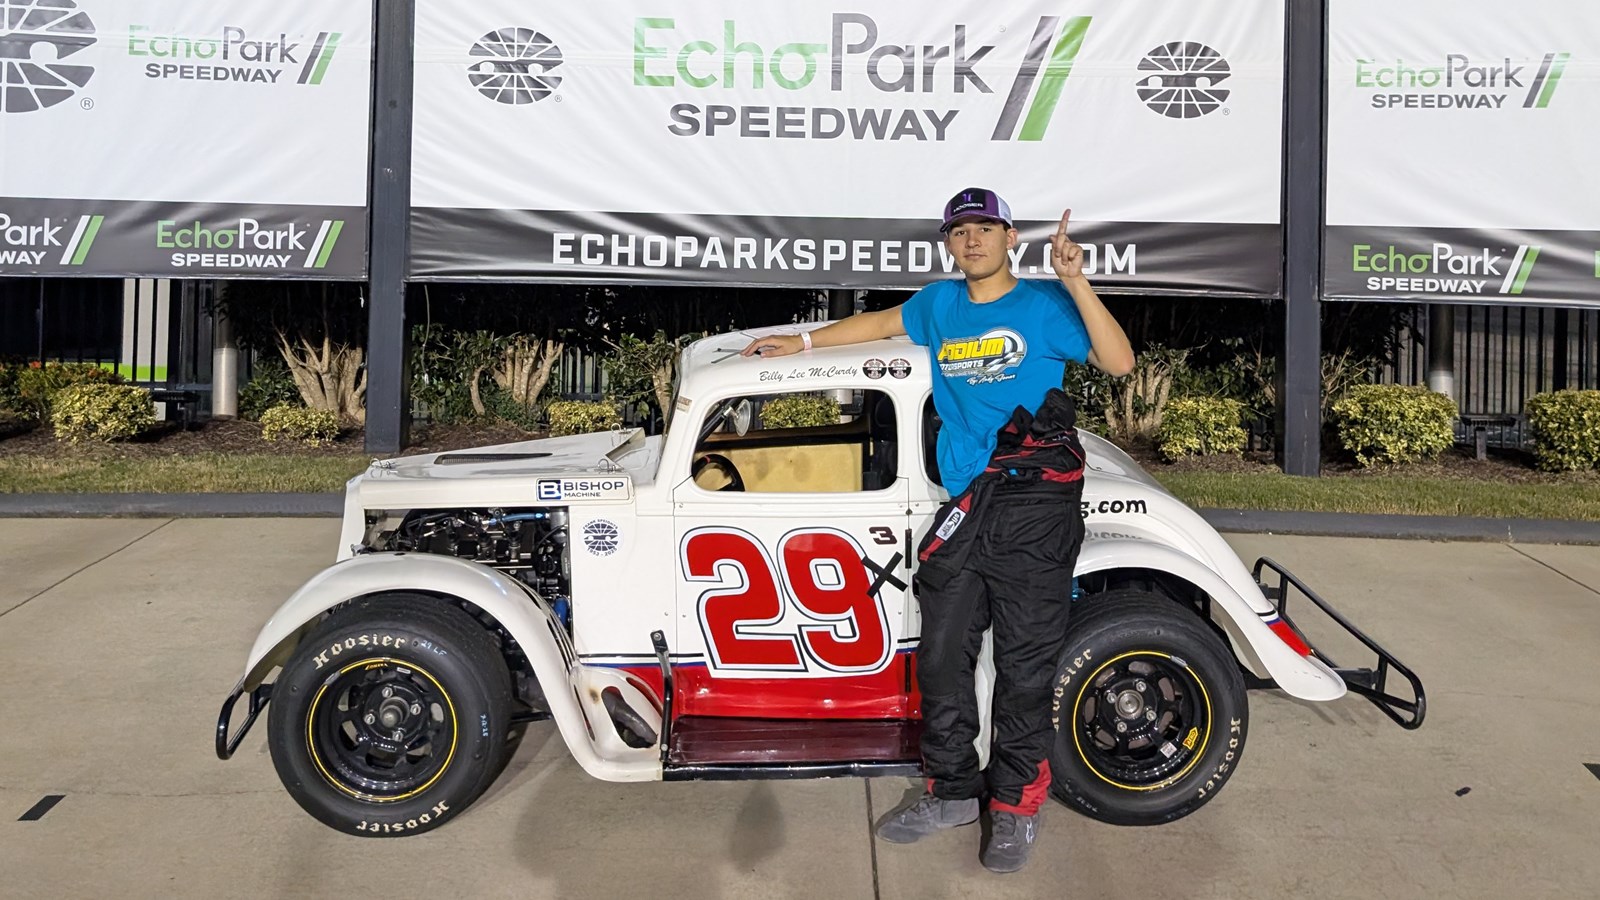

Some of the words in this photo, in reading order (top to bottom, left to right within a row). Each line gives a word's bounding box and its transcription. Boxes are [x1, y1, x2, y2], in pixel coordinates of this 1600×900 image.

[128, 24, 299, 64] EchoPark
[634, 12, 996, 94] EchoPark
[144, 63, 283, 84] SPEEDWAY
[1355, 53, 1525, 88] EchoPark
[1371, 93, 1508, 109] SPEEDWAY
[667, 103, 960, 141] SPEEDWAY
[953, 202, 984, 213] HOOSIER
[156, 218, 306, 251] EchoPark
[171, 252, 292, 269] SPEEDWAY
[1353, 242, 1502, 276] EchoPark
[1366, 277, 1488, 294] SPEEDWAY
[759, 370, 784, 382] Billy
[787, 368, 806, 379] Lee
[808, 364, 858, 379] McCurdy
[563, 481, 624, 491] BISHOP
[869, 526, 898, 545] 3
[679, 525, 892, 673] 29
[312, 633, 406, 670] Hoosier
[1198, 716, 1241, 799] Hoosier
[355, 800, 450, 834] Hoosier
